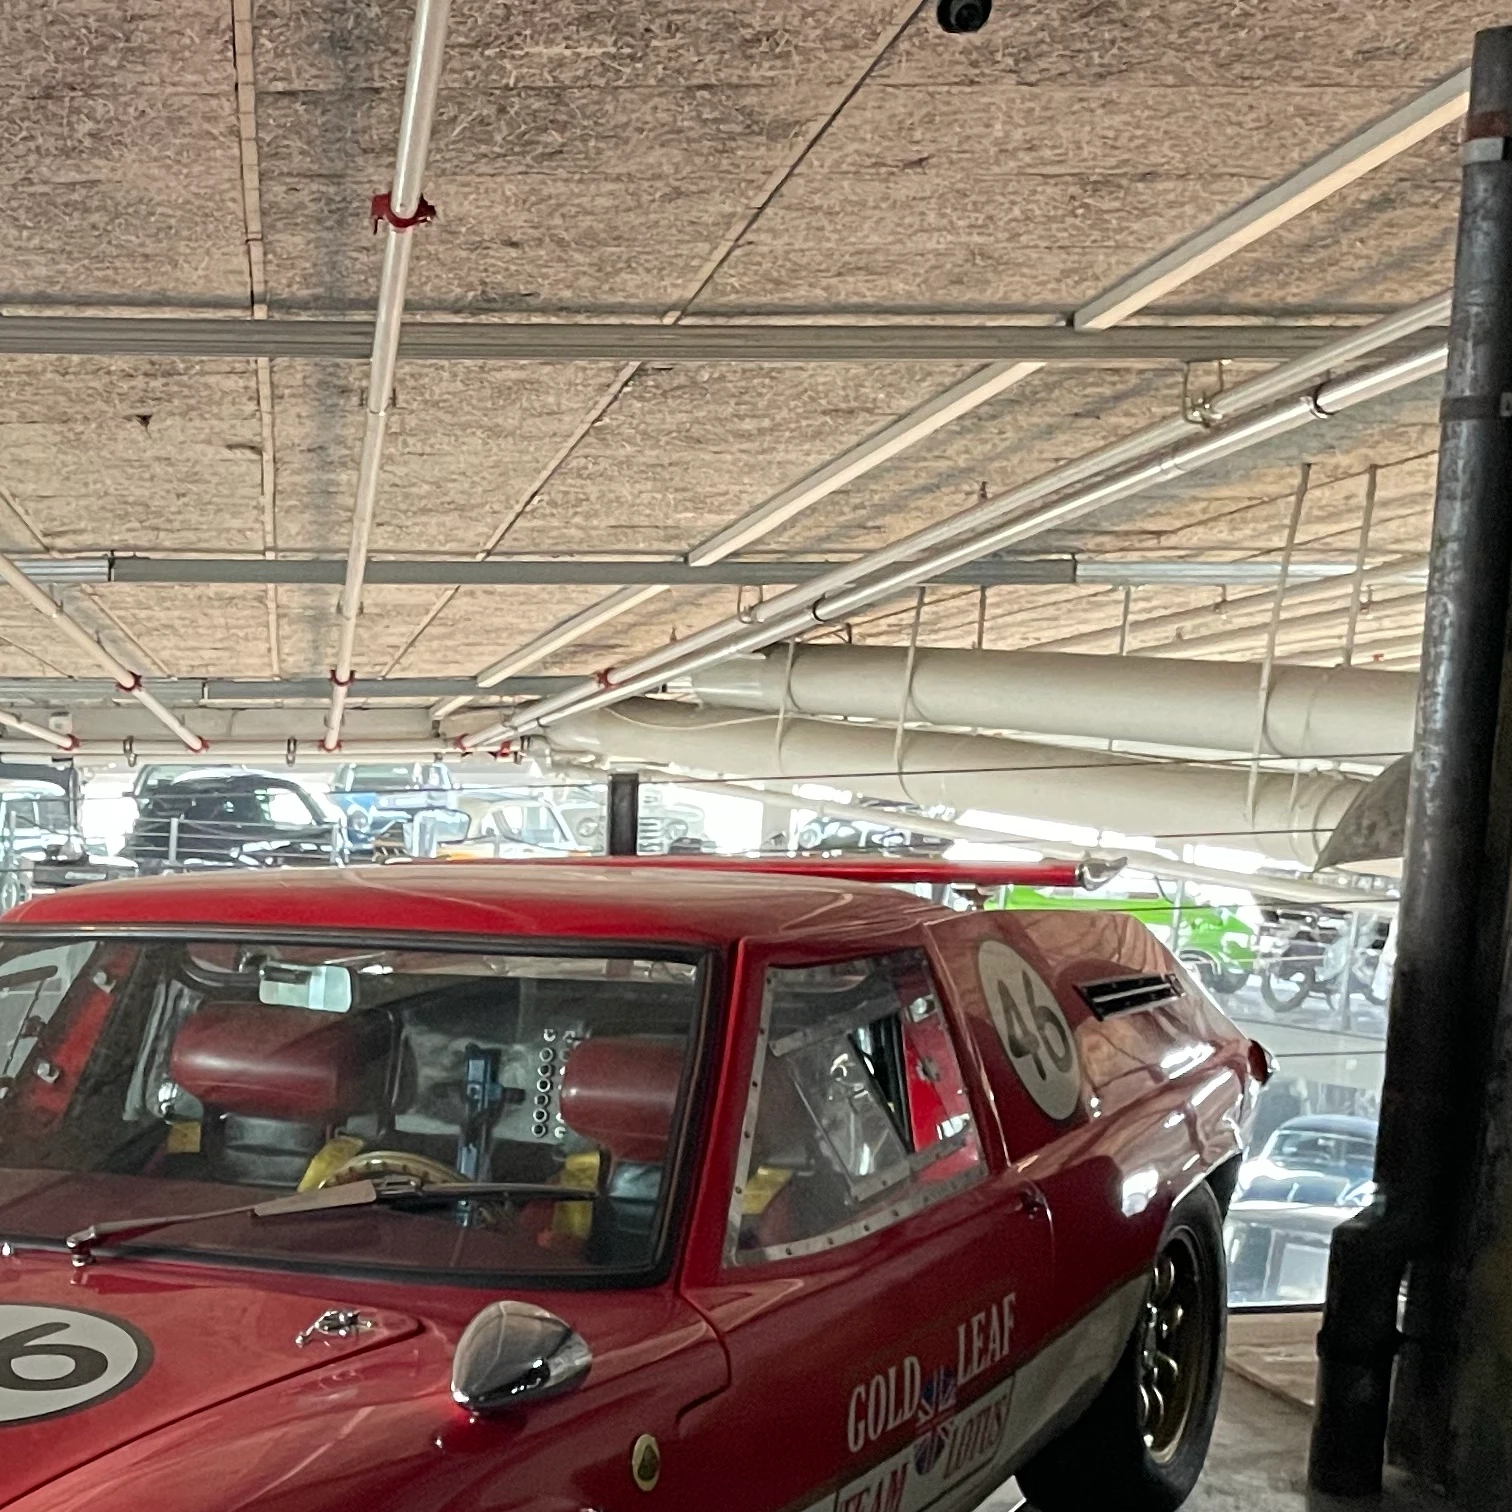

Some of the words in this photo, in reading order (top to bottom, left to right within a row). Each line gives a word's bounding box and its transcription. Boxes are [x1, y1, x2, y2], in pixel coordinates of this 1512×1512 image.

[997, 969, 1074, 1082] 46
[847, 1355, 922, 1453] GOLD
[956, 1292, 1017, 1387] LEAF
